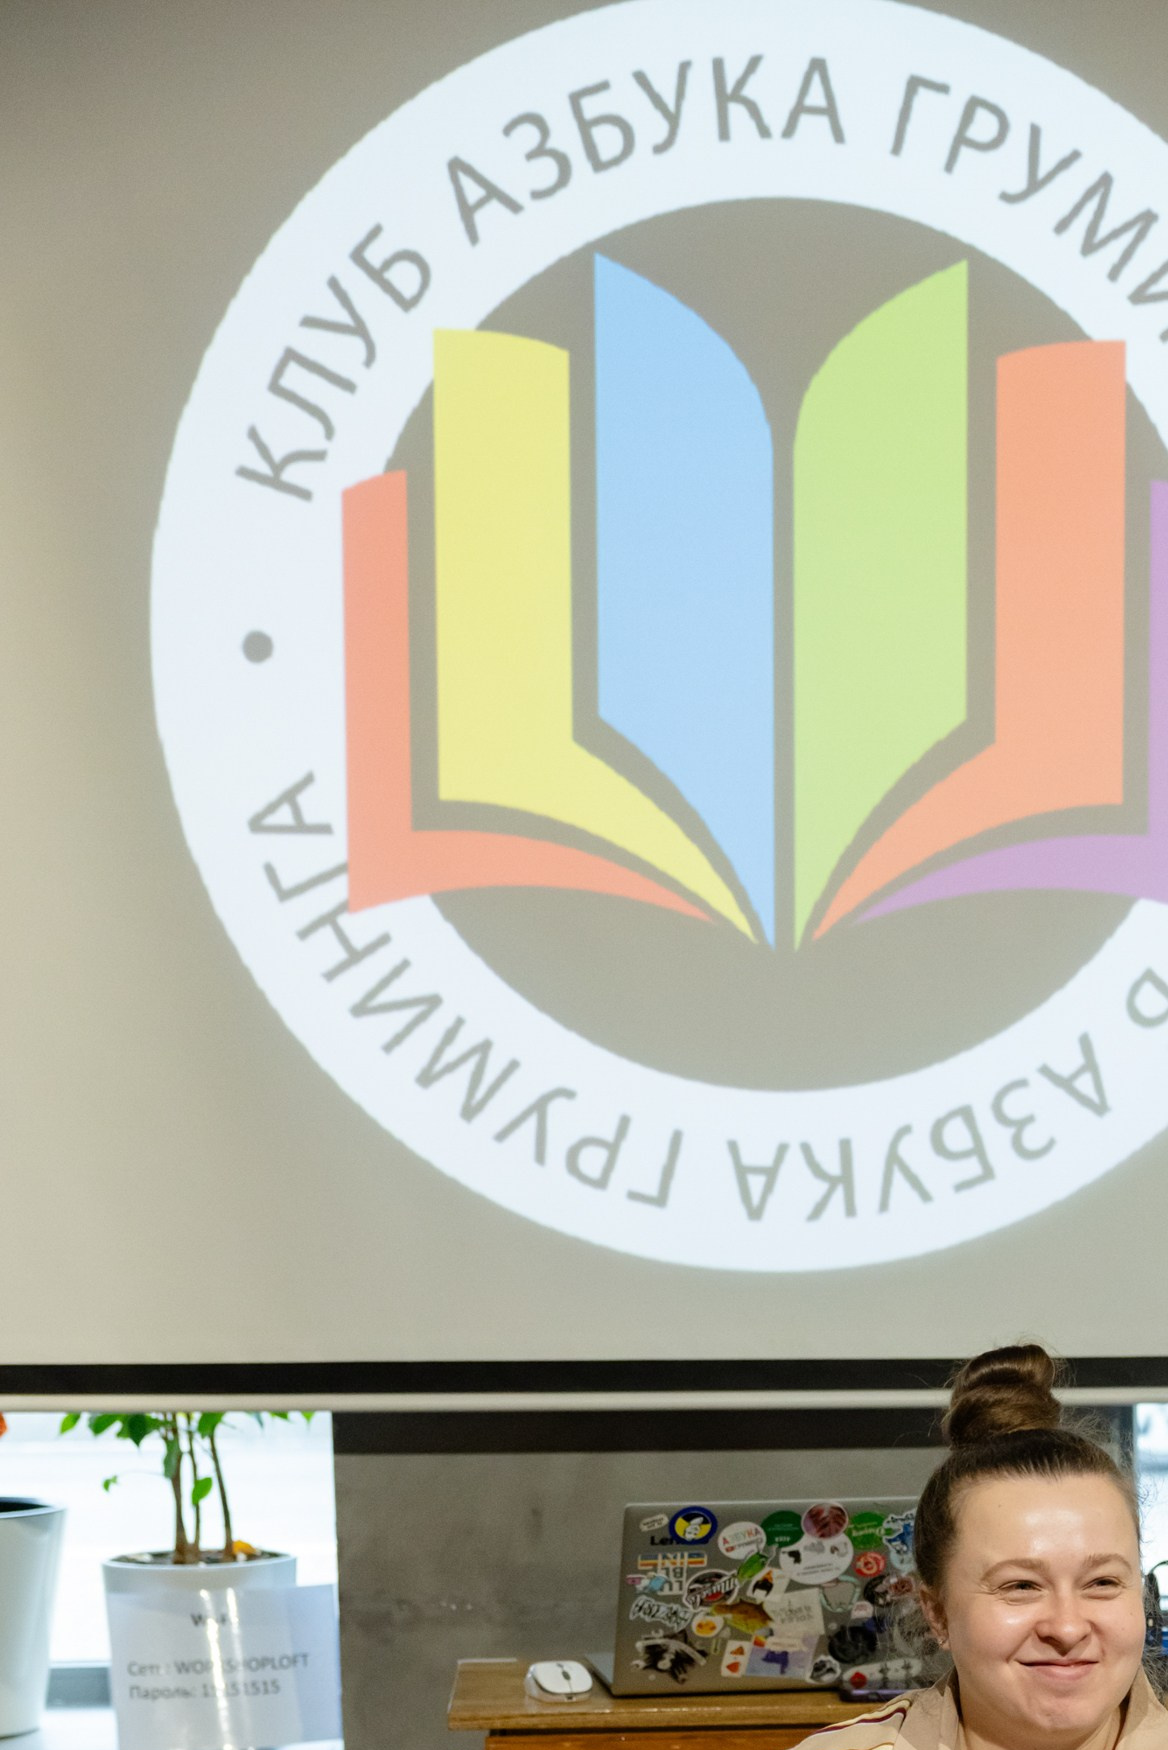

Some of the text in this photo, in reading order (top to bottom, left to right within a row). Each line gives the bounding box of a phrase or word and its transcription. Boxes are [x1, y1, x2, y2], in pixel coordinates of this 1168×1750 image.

[234, 222, 433, 502] КЛУБ
[445, 54, 848, 245] АЗБУКА
[245, 771, 684, 1210] ГРУМИНГА
[726, 1032, 1114, 1224] АЗБУКА
